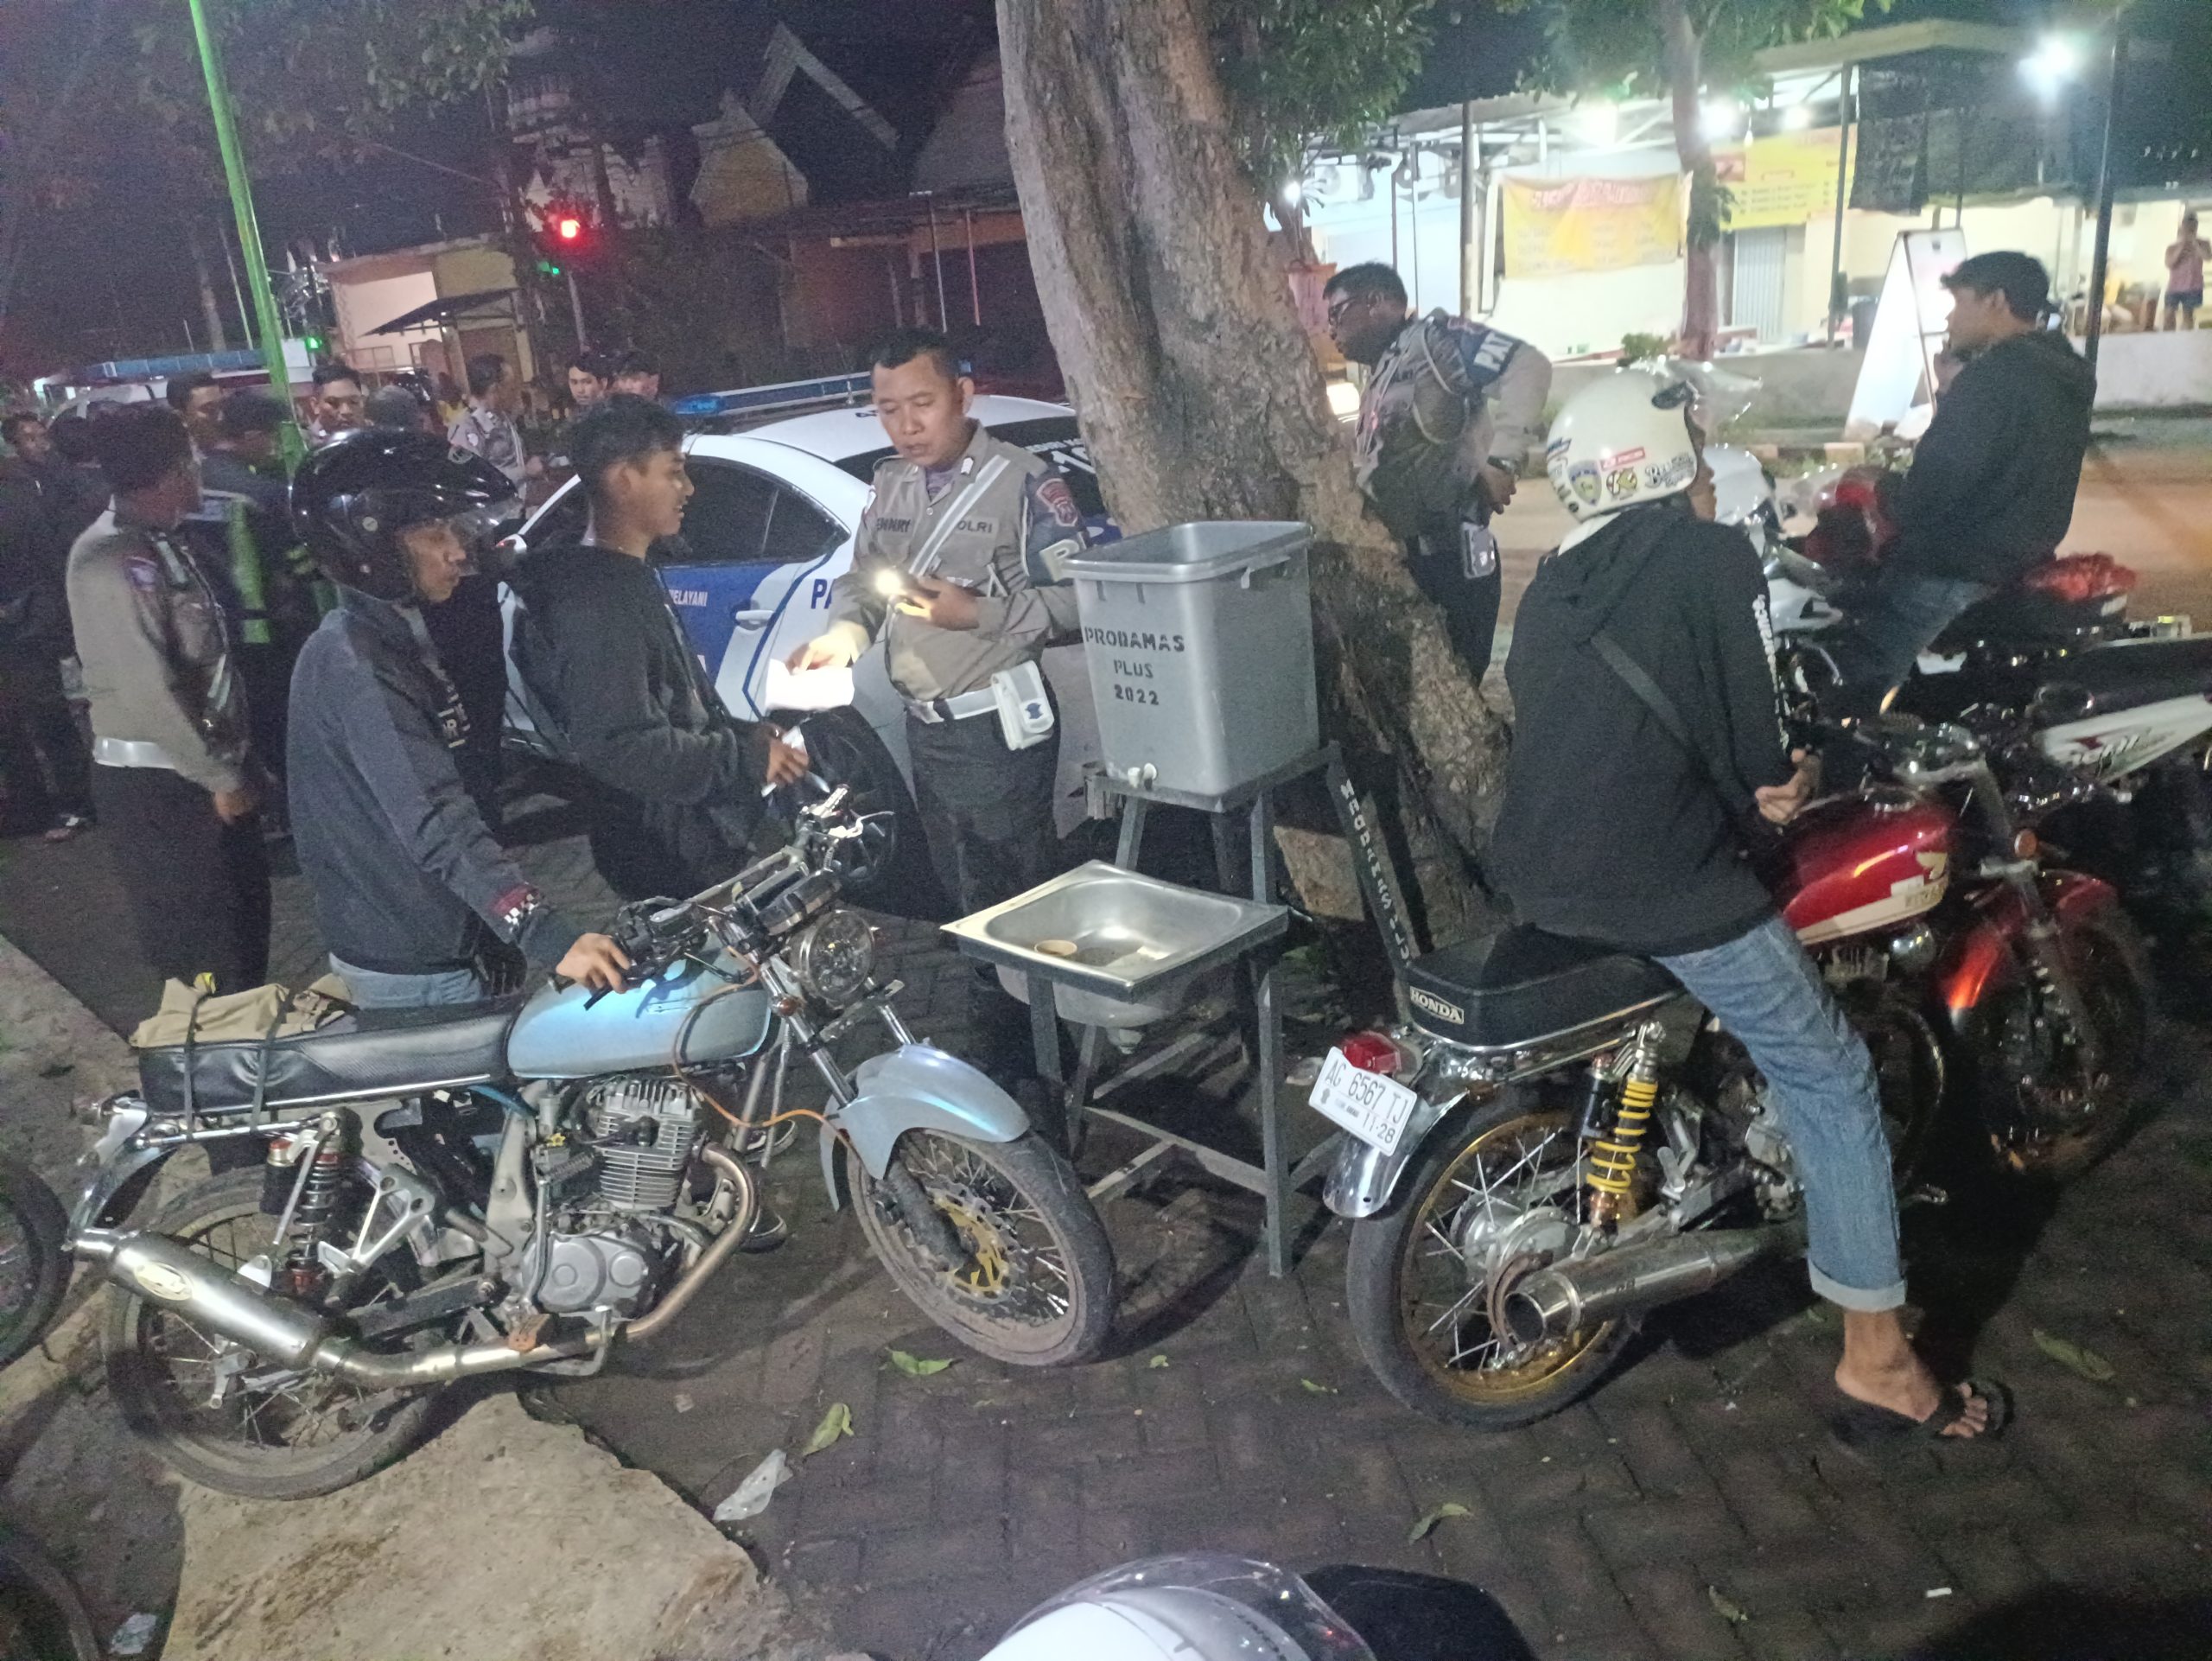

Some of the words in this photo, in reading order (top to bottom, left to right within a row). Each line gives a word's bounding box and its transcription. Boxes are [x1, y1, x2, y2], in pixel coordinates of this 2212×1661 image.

[957, 519, 993, 533] OLRI
[1114, 659, 1154, 679] PLUS
[1114, 684, 1160, 706] 2022
[1409, 988, 1463, 1024] HONDA
[1348, 1072, 1387, 1111] 6567
[1386, 1091, 1408, 1124] TJ
